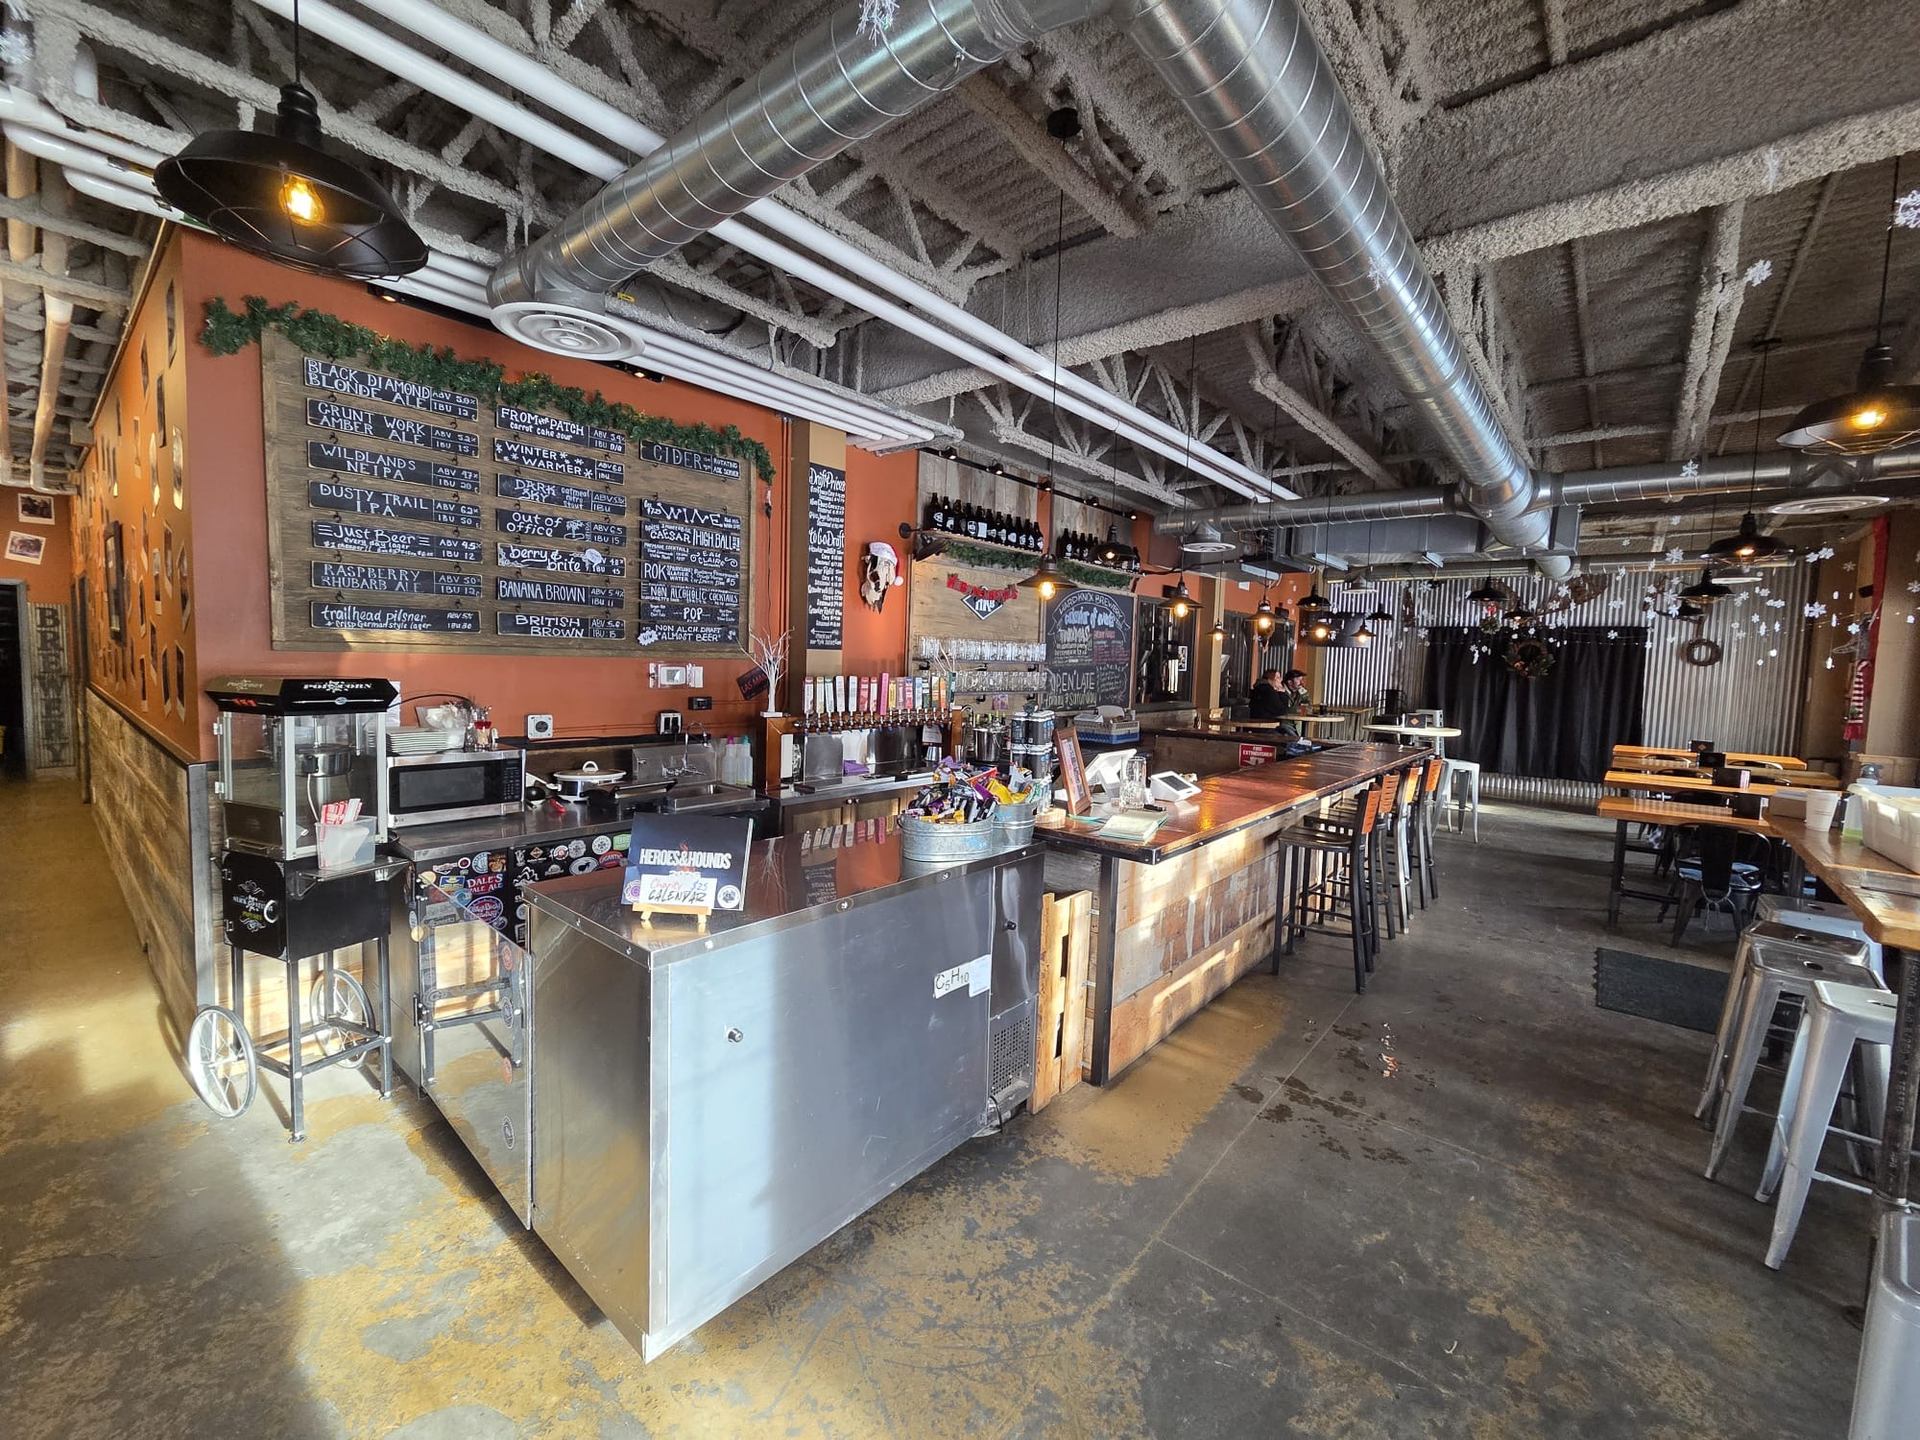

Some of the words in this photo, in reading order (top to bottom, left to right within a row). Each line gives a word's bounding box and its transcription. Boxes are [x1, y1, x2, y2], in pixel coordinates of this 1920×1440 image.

[308, 359, 359, 384] BLACK
[367, 374, 431, 400] DIAMOND
[309, 373, 382, 401] BLONDE
[392, 391, 428, 411] ALE
[433, 402, 452, 413] IBU
[458, 407, 469, 416] 12
[318, 402, 375, 424] GRUNT
[384, 416, 425, 436] WORK
[501, 407, 538, 426] FROM
[550, 419, 586, 437] PATCH
[320, 415, 374, 436] AMBER
[389, 430, 424, 447] ALE
[434, 430, 452, 439] ABV
[509, 421, 533, 433] carrot
[536, 427, 555, 438] cake
[556, 431, 574, 441] sour
[436, 440, 451, 449] IBU
[458, 444, 470, 453] 15
[505, 441, 557, 460] WINTER
[595, 440, 608, 449] IBU
[320, 443, 417, 471] WILDLANDS
[653, 444, 702, 470] CIDER
[346, 461, 405, 481] NEIPA
[437, 467, 456, 477] ABV
[521, 456, 582, 476] WARMER
[598, 462, 612, 470] ABV
[598, 472, 610, 480] IBU
[438, 478, 456, 487] IBU
[460, 482, 472, 490] 20
[514, 478, 557, 496] DARK
[319, 483, 374, 502] DUSTY
[382, 493, 429, 510] TRAIL
[519, 489, 549, 504] SKY
[594, 494, 612, 502] ABV
[436, 502, 456, 512] ABV
[593, 504, 611, 512] IBU
[438, 514, 455, 523] IBU
[460, 517, 472, 525] 50
[657, 502, 723, 528] WINE
[545, 517, 563, 529] of
[593, 524, 609, 533] ABV
[374, 529, 416, 544] Beer
[439, 538, 459, 548] ABV
[594, 535, 609, 543] IBU
[650, 530, 691, 544] CAESAR
[696, 530, 714, 548] HIGH
[714, 534, 733, 551] BALL
[442, 549, 460, 558] IBU
[463, 552, 476, 561] 12
[509, 545, 548, 563] berry
[665, 544, 689, 553] COCKTAILS
[702, 550, 721, 558] EAU
[547, 558, 582, 572] brite
[698, 556, 726, 567] CLAIRE
[323, 563, 420, 582] RASPBERRY
[644, 562, 668, 581] ROK
[321, 576, 388, 591] RHUBARB
[395, 582, 422, 593] ALE
[438, 575, 460, 583] ABV
[440, 585, 460, 594] IBU
[500, 580, 543, 600] BANANA
[545, 584, 586, 604] BROWN
[590, 588, 606, 597] ABV
[650, 585, 668, 598] NON
[670, 587, 707, 601] ALCOHOLIC
[708, 591, 739, 604] COCKTAILS
[591, 597, 605, 606] IBU
[607, 599, 614, 607] 11
[321, 605, 383, 622] trailhead
[387, 609, 427, 626] pilsner
[683, 606, 704, 621] POP
[515, 615, 581, 627] BRITISH
[591, 620, 605, 628] ABV
[530, 626, 585, 638] BROWN
[655, 624, 675, 633] NON
[700, 627, 723, 635] DRAFT
[36, 606, 69, 764] BREWERY
[1077, 672, 1096, 693] LATE
[466, 873, 504, 887] DALE'S
[488, 881, 504, 891] ALE
[648, 887, 708, 905] CALENDAR
